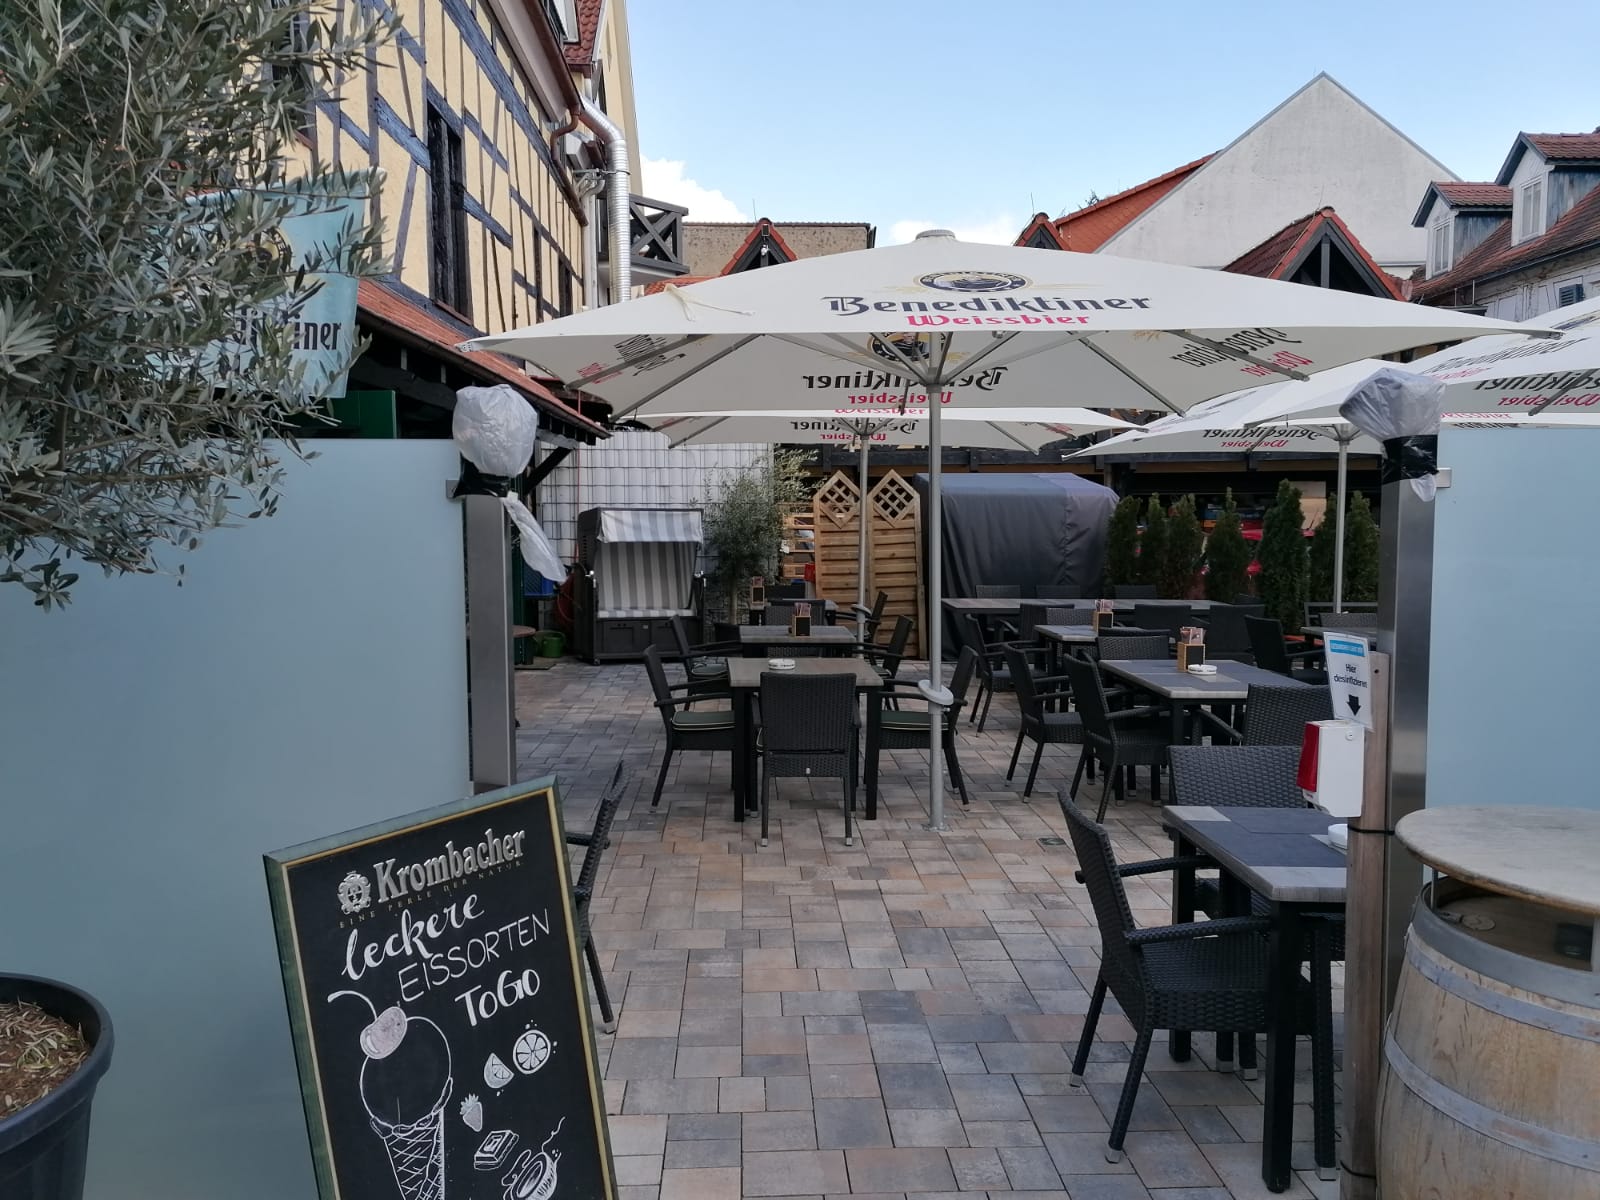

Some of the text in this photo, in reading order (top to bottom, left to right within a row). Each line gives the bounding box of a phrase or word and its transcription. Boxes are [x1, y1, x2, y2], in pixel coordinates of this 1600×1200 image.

[820, 296, 1151, 316] Benediktiner
[907, 314, 1089, 326] Weissbier
[340, 911, 376, 928] EINE
[388, 891, 432, 911] PERLE
[478, 861, 521, 880] NATUR
[373, 828, 526, 903] Krombacher
[341, 893, 485, 981] leckere
[398, 908, 550, 1003] EISSORTEN
